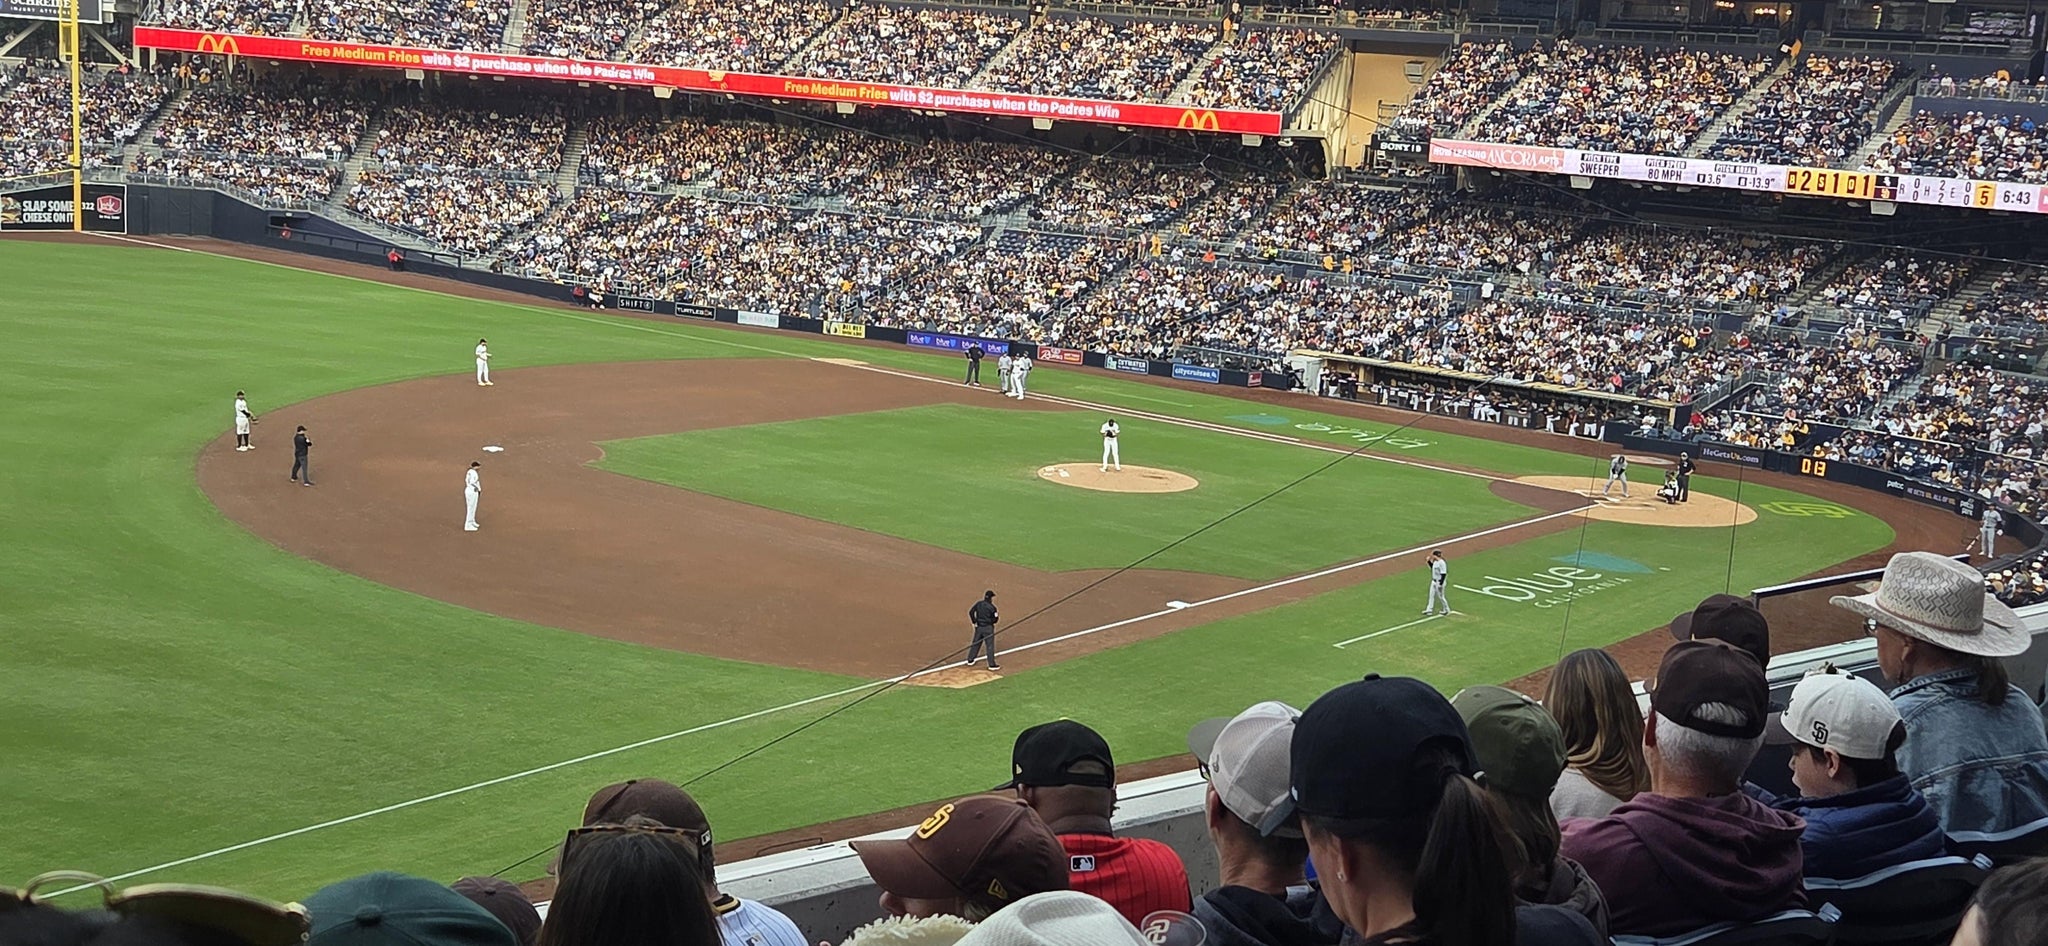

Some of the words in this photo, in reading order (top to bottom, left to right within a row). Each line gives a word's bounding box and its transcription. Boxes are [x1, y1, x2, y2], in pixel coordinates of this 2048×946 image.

[302, 44, 330, 57] Free
[333, 46, 385, 61] Medium
[388, 51, 420, 64] Fries
[422, 53, 451, 66] with
[453, 55, 471, 68] $2
[471, 58, 531, 72] purchase
[533, 61, 569, 75] when
[570, 63, 592, 76] the
[633, 68, 654, 81] Win
[784, 82, 809, 94] Free
[811, 84, 857, 98] Medium
[859, 87, 888, 100] Fries
[890, 89, 917, 102] with
[918, 92, 934, 105] $2
[935, 94, 990, 108] purchase
[992, 98, 1026, 111] when
[1027, 100, 1049, 113] the
[1050, 101, 1093, 116] Padres
[1095, 105, 1120, 119] Win
[1579, 163, 1620, 177] SWEEPER
[1648, 168, 1659, 179] 80
[1661, 169, 1682, 182] MPH
[1800, 170, 1812, 191] 2
[1833, 172, 1839, 194] 1
[1863, 174, 1870, 196] 1
[1914, 178, 1921, 189] 0
[1939, 180, 1946, 191] 2
[1965, 181, 1971, 193] 0
[1899, 184, 1905, 194] R
[1924, 186, 1930, 197] H
[1950, 187, 1955, 198] E
[1912, 190, 1919, 201] 0
[1937, 193, 1944, 203] 2
[1963, 194, 1970, 206] 0
[1980, 190, 1989, 206] 5
[2003, 190, 2031, 205] 6:43
[23, 200, 47, 212] SLAP
[48, 200, 75, 212] SOME
[81, 202, 95, 211] 322
[23, 212, 53, 223] CHEESE
[53, 213, 65, 223] ON
[935, 338, 950, 347] blue
[1174, 367, 1210, 378] citycruises
[1702, 447, 1759, 464] HeGetsUs.com
[1453, 566, 1602, 602] blue
[1533, 577, 1633, 609] CALIFORNIA
[1812, 720, 1829, 745] SD
[916, 803, 955, 840] SD
